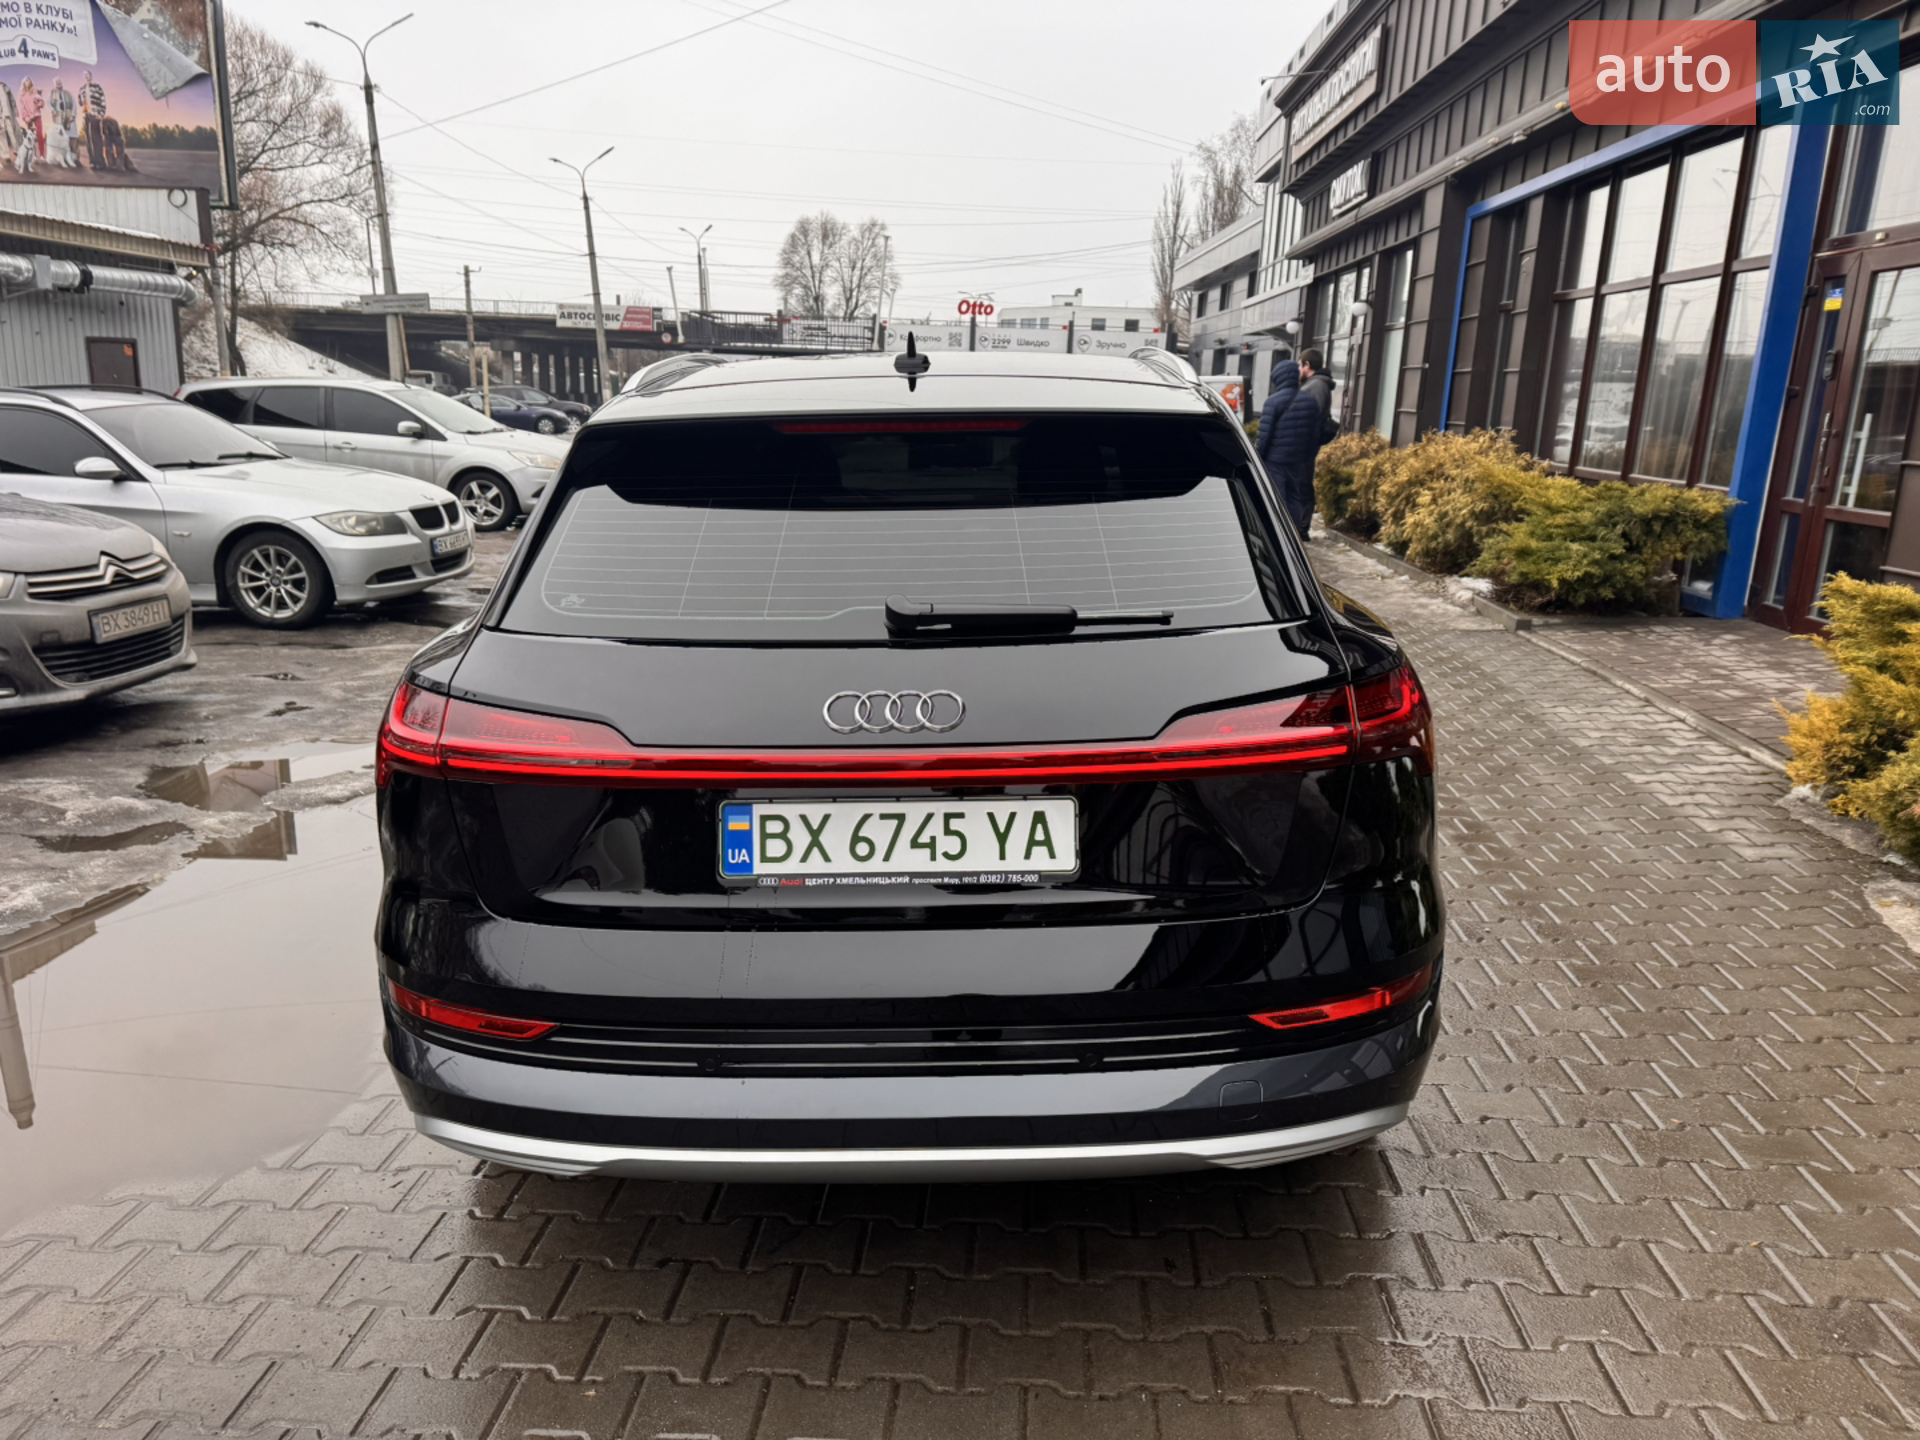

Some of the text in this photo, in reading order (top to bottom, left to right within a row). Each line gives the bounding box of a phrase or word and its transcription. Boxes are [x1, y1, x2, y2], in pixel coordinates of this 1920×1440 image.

[23, 2, 32, 14] В
[35, 3, 73, 21] КЛУБІ
[25, 17, 78, 37] РАНКУ»!
[17, 37, 29, 58] 4
[31, 48, 57, 62] PAWS
[957, 299, 995, 316] Otto
[559, 311, 621, 322] АВТОСВІС
[899, 334, 942, 344] Кофортно
[1016, 337, 1050, 348] Швидко
[1095, 340, 1127, 350] Зручно
[100, 613, 121, 633] BX
[759, 810, 1057, 864] BX 6745 YA
[728, 848, 750, 864] UA
[805, 877, 834, 886] ЦЕНТР
